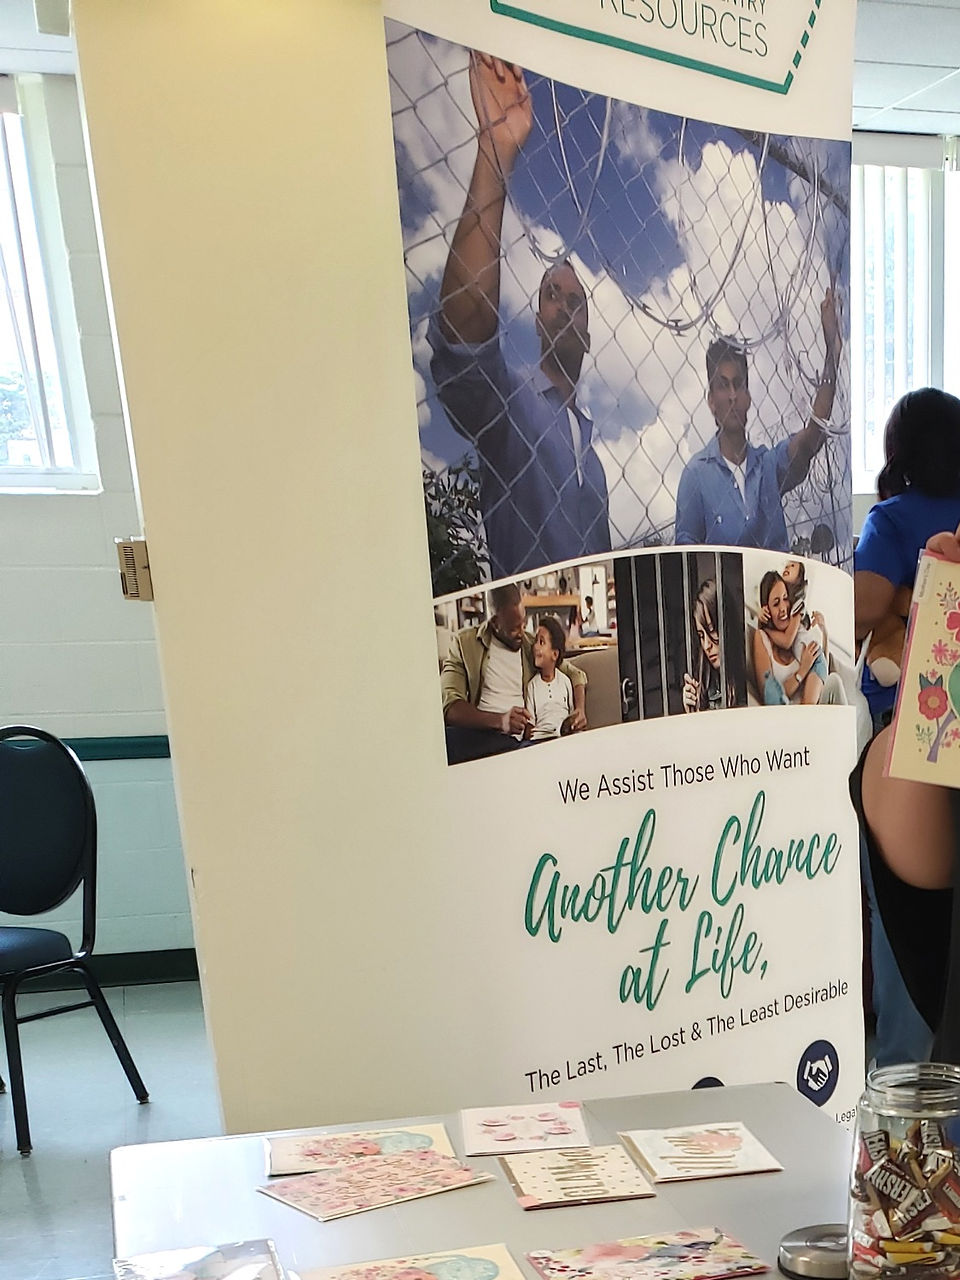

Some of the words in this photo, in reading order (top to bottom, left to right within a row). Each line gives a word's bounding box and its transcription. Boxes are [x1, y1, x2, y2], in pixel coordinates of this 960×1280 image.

[600, 0, 768, 57] SOURCES
[558, 780, 590, 805] We
[597, 769, 655, 799] Assist
[660, 763, 715, 789] Those
[720, 754, 762, 779] Who
[765, 746, 811, 772] Want
[524, 808, 700, 944] Another
[711, 789, 843, 907] Chance
[619, 917, 671, 1012] at
[685, 903, 769, 1000] Life,
[525, 1067, 562, 1094] The
[566, 1053, 608, 1082] Last,
[612, 1041, 645, 1063] The
[650, 1027, 687, 1054] Lost
[690, 1022, 703, 1041] &
[707, 1013, 736, 1035] The
[740, 999, 780, 1026] Least
[783, 980, 849, 1013] Desirable
